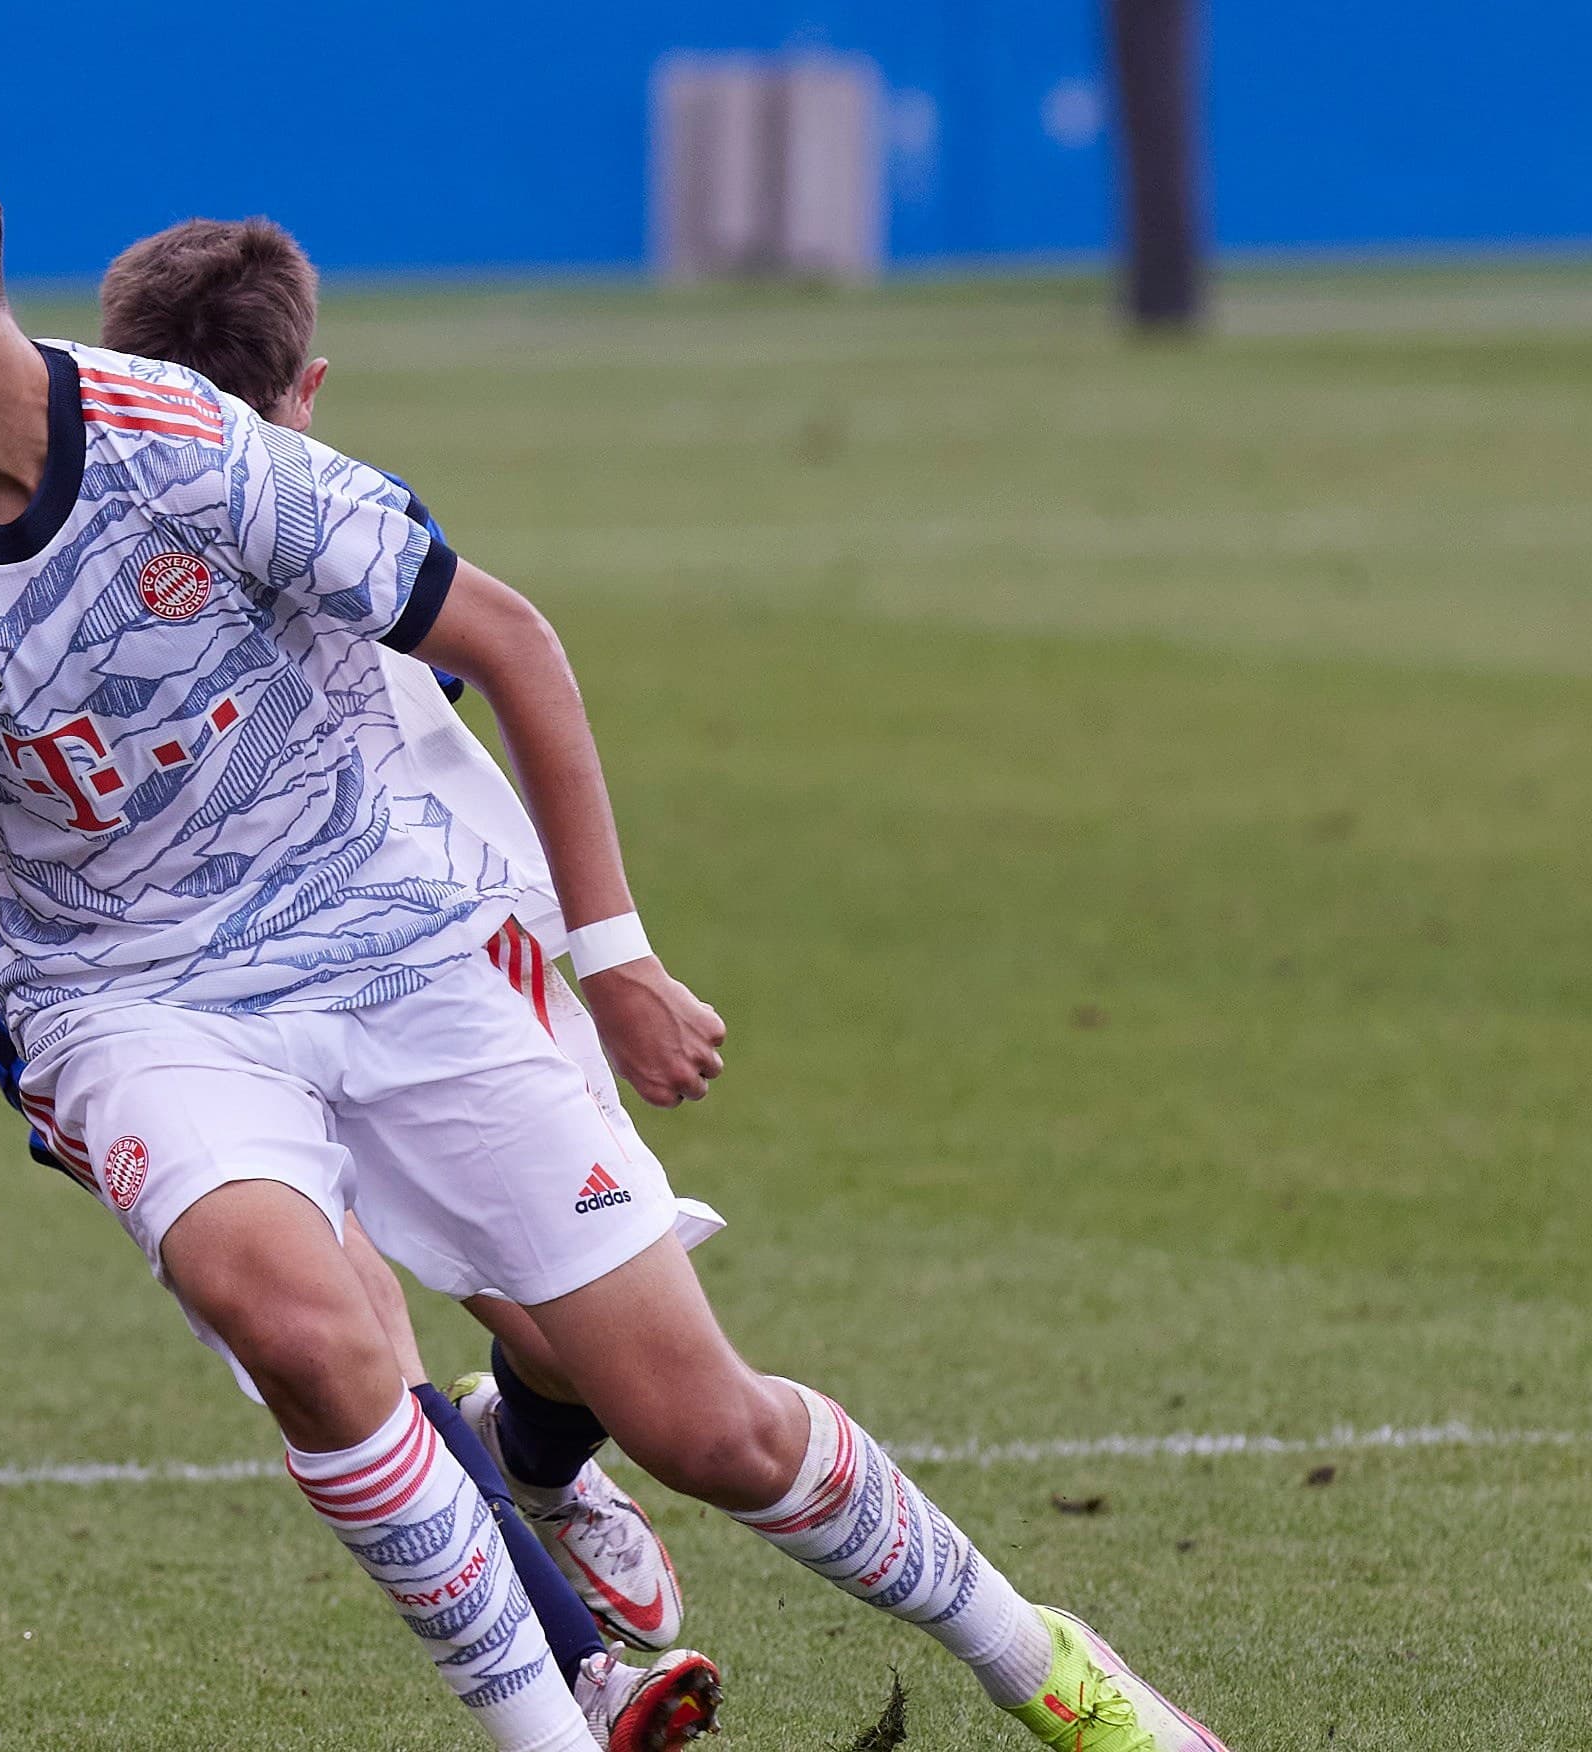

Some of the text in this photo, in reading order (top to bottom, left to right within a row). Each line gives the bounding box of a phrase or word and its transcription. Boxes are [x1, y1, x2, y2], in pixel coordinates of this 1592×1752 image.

[144, 557, 199, 592] FC BAYERN
[575, 1189, 631, 1213] adidas
[859, 1468, 909, 1587] BAYERN
